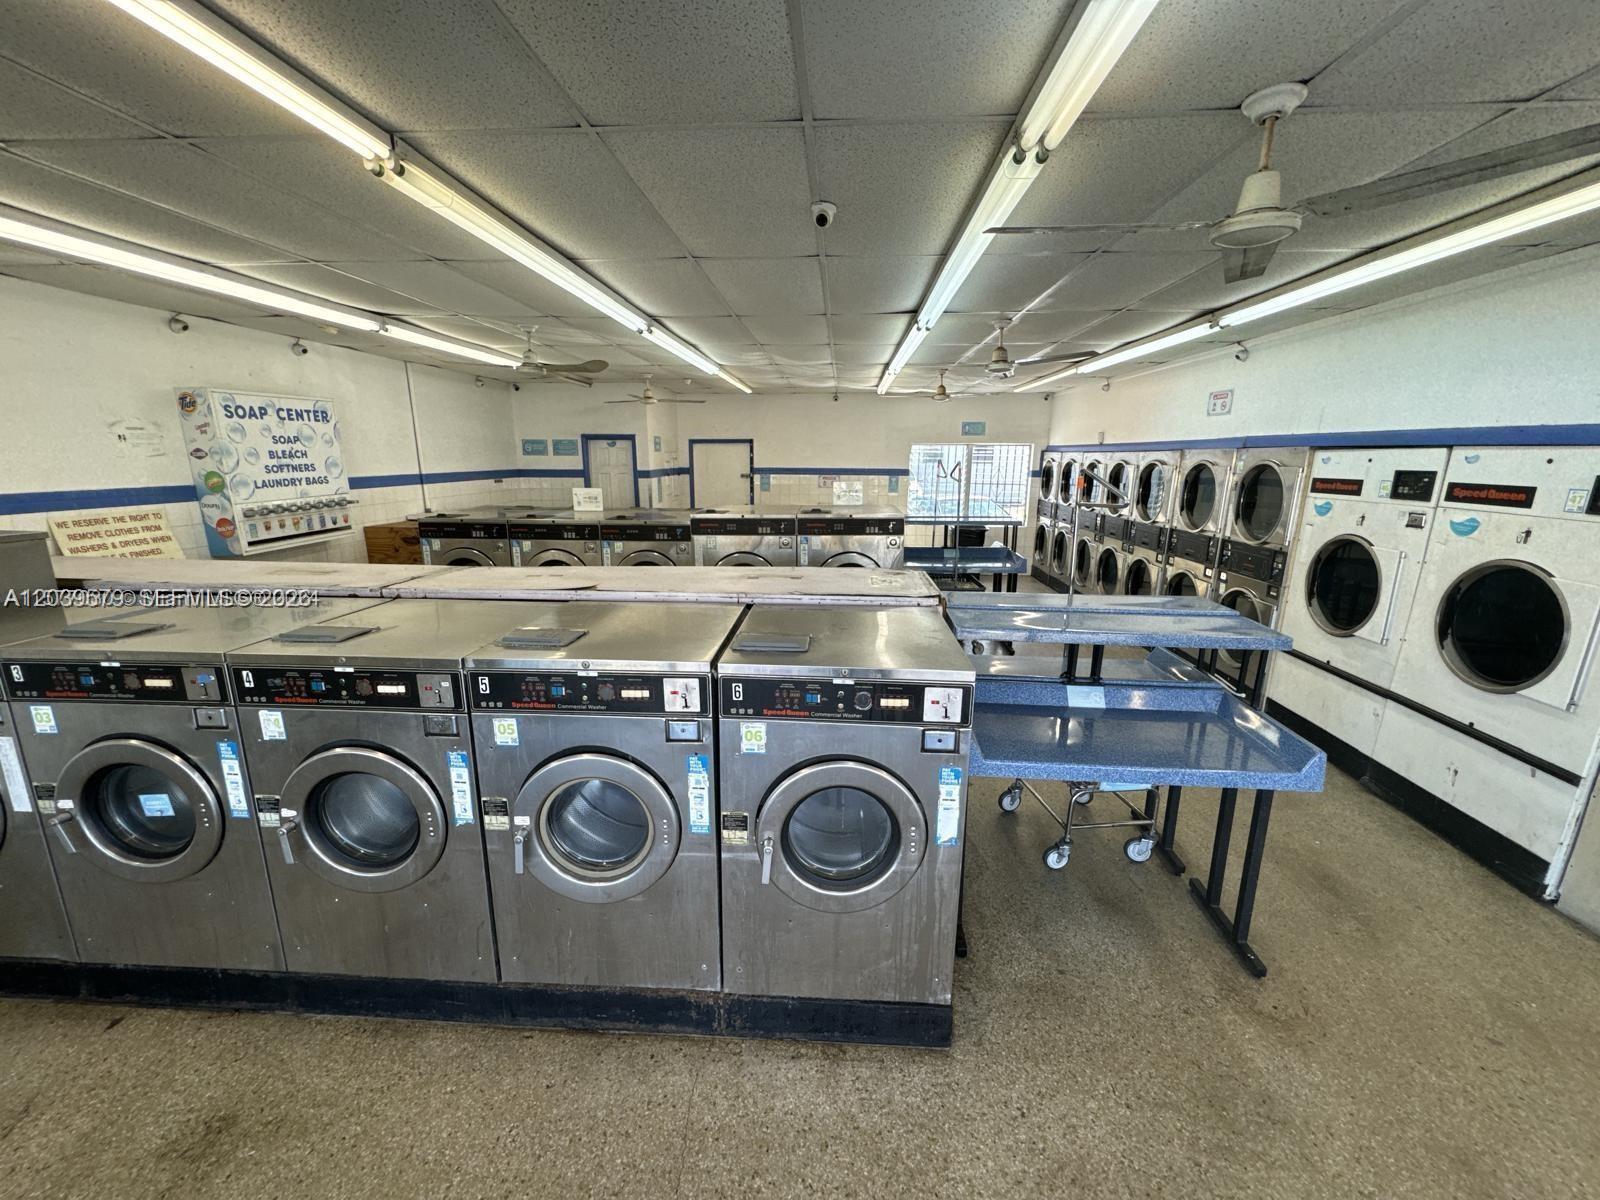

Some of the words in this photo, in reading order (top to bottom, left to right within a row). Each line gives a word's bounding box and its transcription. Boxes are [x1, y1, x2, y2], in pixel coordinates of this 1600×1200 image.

[179, 396, 196, 410] Tide
[223, 404, 268, 420] SOAP
[276, 407, 330, 423] CENTER
[272, 435, 300, 445] SOAP
[268, 449, 308, 459] BLEACH
[264, 463, 316, 474] SOFTNERS
[254, 478, 303, 489] LAUNDRY
[305, 476, 329, 485] BAGS
[1452, 487, 1487, 498] Speed
[1488, 489, 1526, 501] Queen
[54, 520, 70, 529] WE
[72, 517, 110, 528] RESERVE
[112, 516, 127, 524] THE
[128, 513, 150, 523] RIGHT
[152, 512, 162, 520] TO
[67, 531, 103, 542] REMOVE
[104, 526, 140, 538] CLOTHES
[141, 524, 162, 533] FROM
[67, 542, 109, 555] WASHERS
[119, 537, 150, 548] DRYERS
[151, 535, 172, 544] WHEN
[13, 666, 21, 680] 3
[245, 671, 252, 687] 4
[480, 678, 488, 692] 5
[733, 685, 741, 699] 6
[34, 712, 51, 724] 03
[763, 708, 786, 716] Speed
[497, 723, 515, 735] 05
[744, 730, 763, 741] 06
